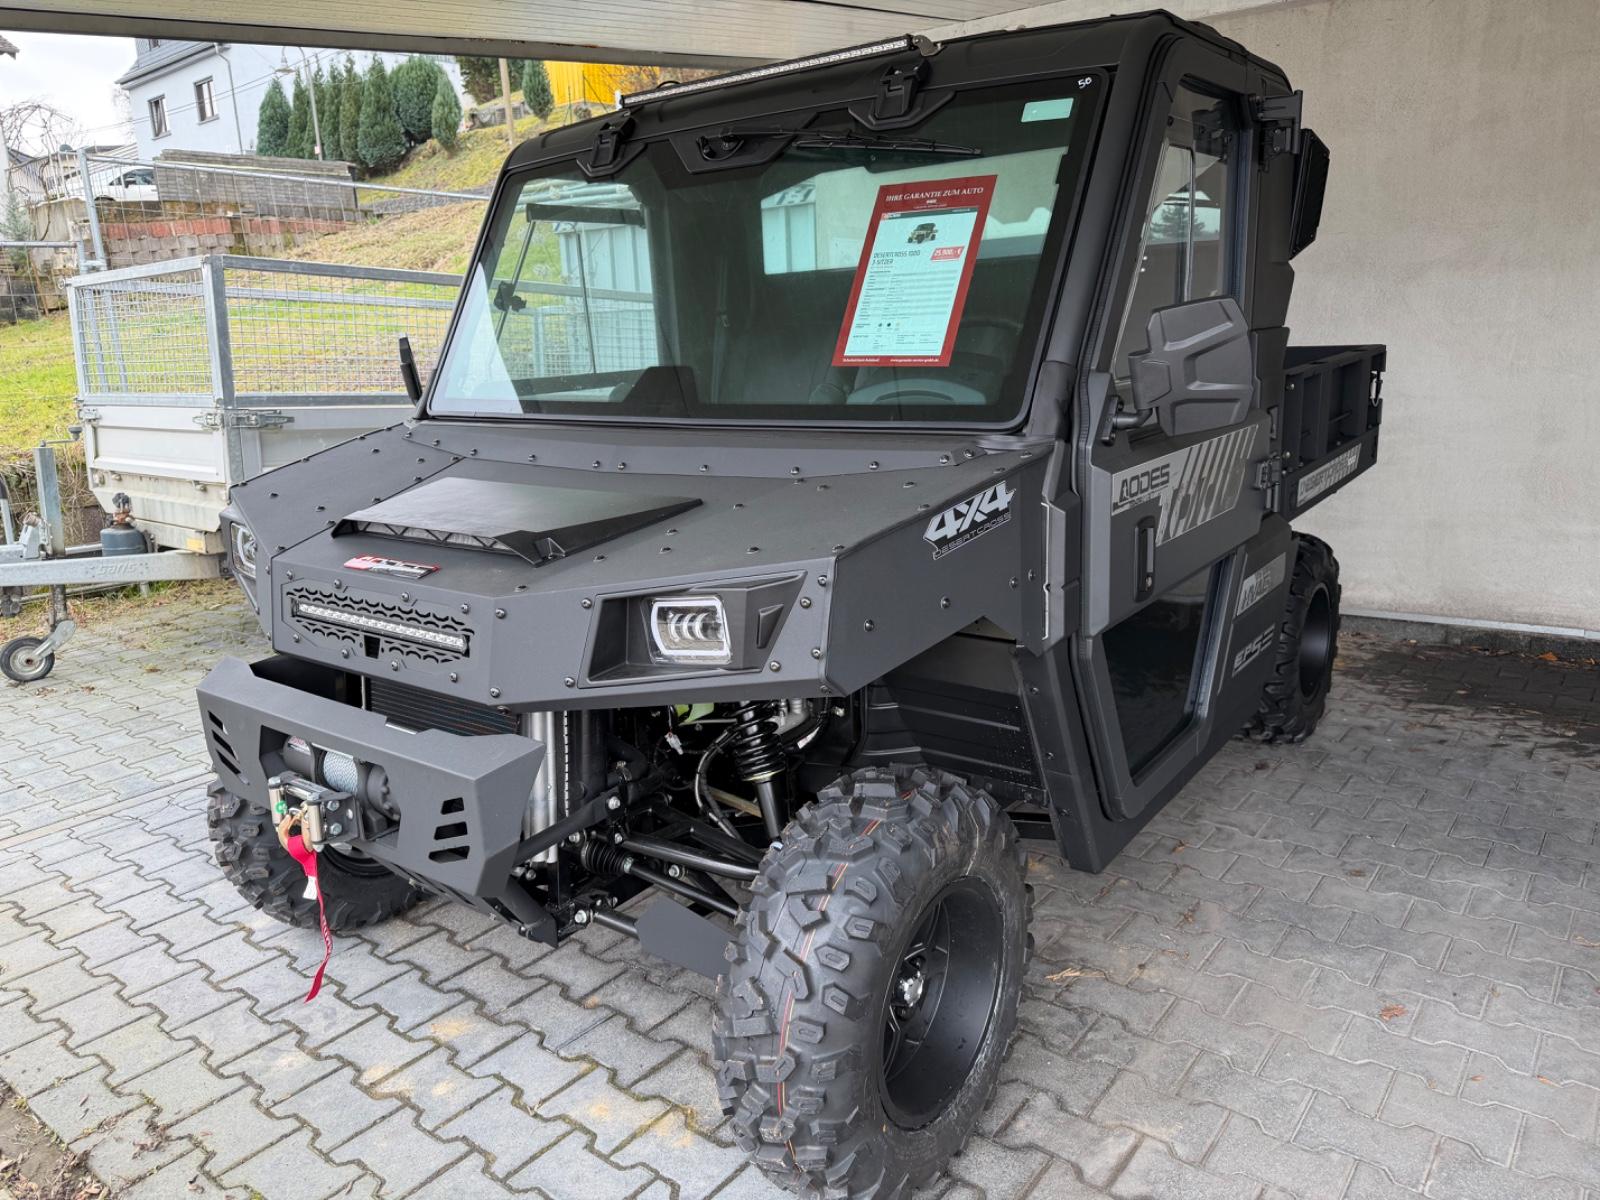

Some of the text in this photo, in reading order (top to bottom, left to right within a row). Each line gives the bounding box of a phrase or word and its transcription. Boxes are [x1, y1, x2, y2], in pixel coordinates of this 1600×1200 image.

[885, 187, 984, 202] IHRE GARANTIE ZUM AUTO
[1119, 463, 1170, 503] AODES
[923, 480, 1015, 541] 4X4
